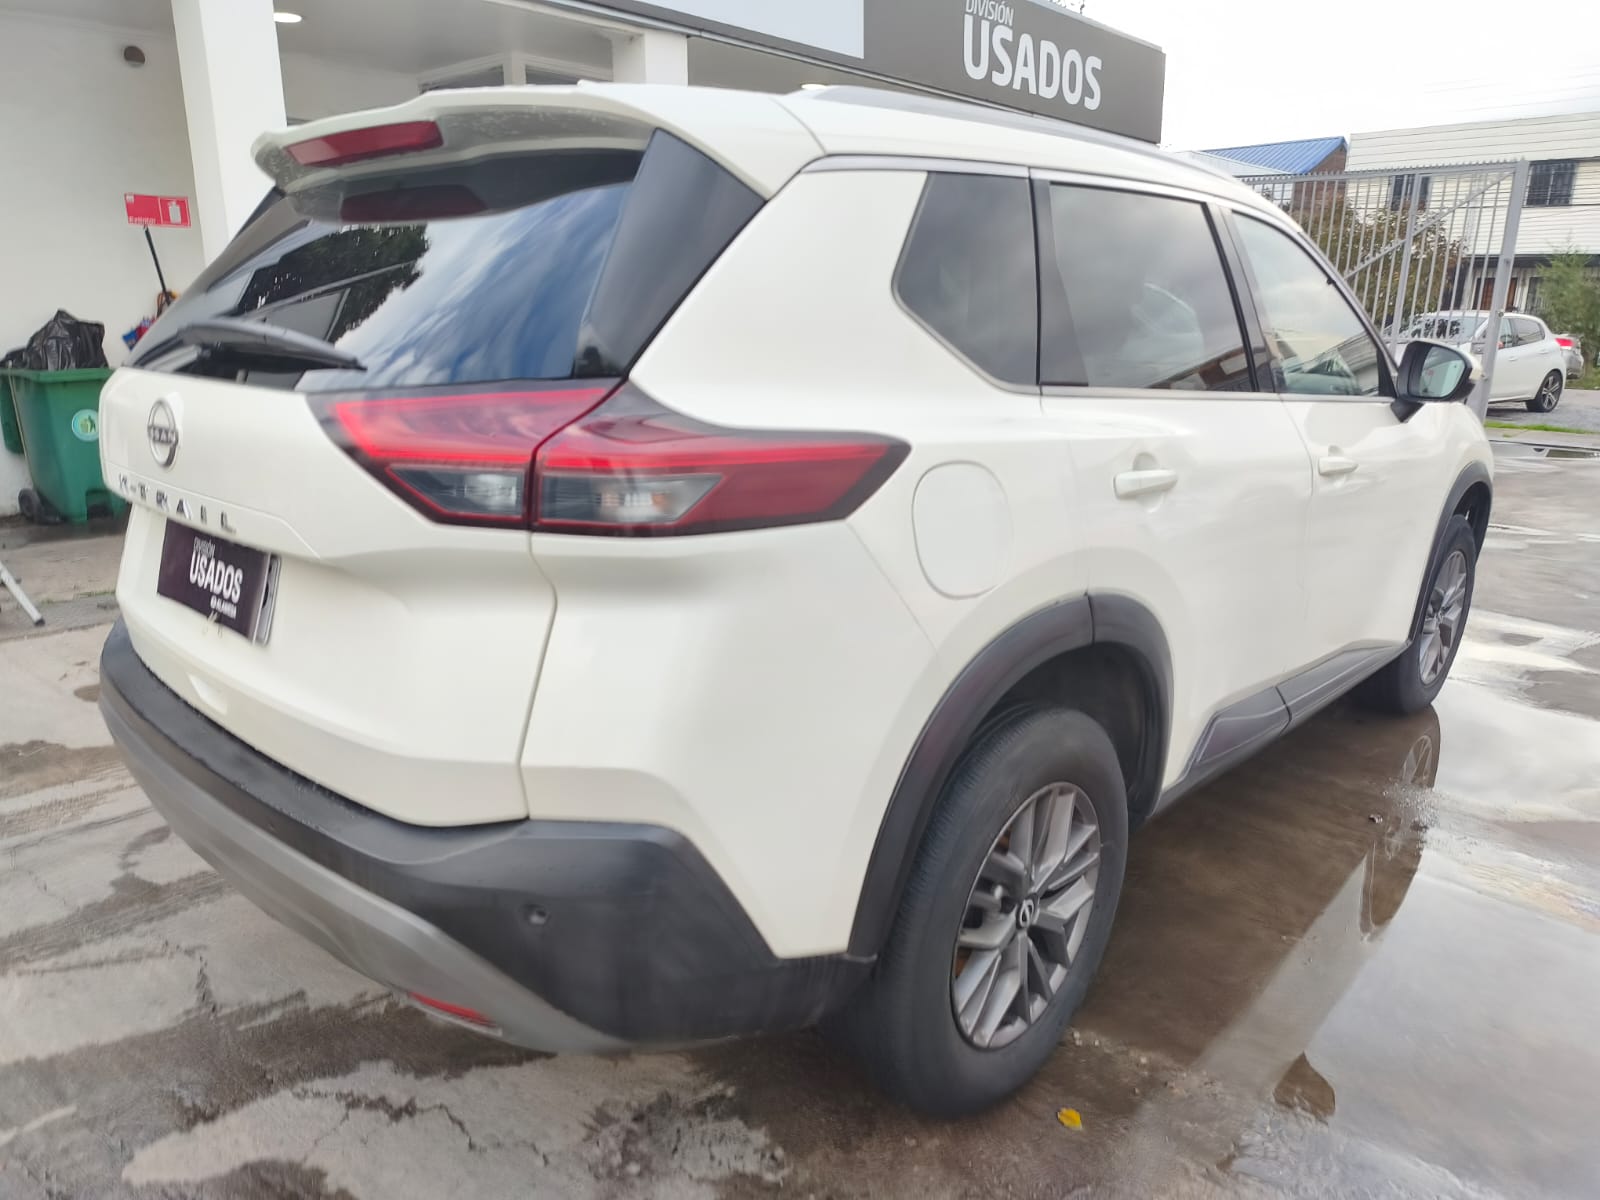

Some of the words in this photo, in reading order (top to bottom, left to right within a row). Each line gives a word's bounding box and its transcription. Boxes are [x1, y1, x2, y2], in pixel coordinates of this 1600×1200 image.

[966, 0, 1014, 26] DIVISIÓN
[963, 13, 1102, 110] USADOS
[189, 550, 243, 604] USADOS
